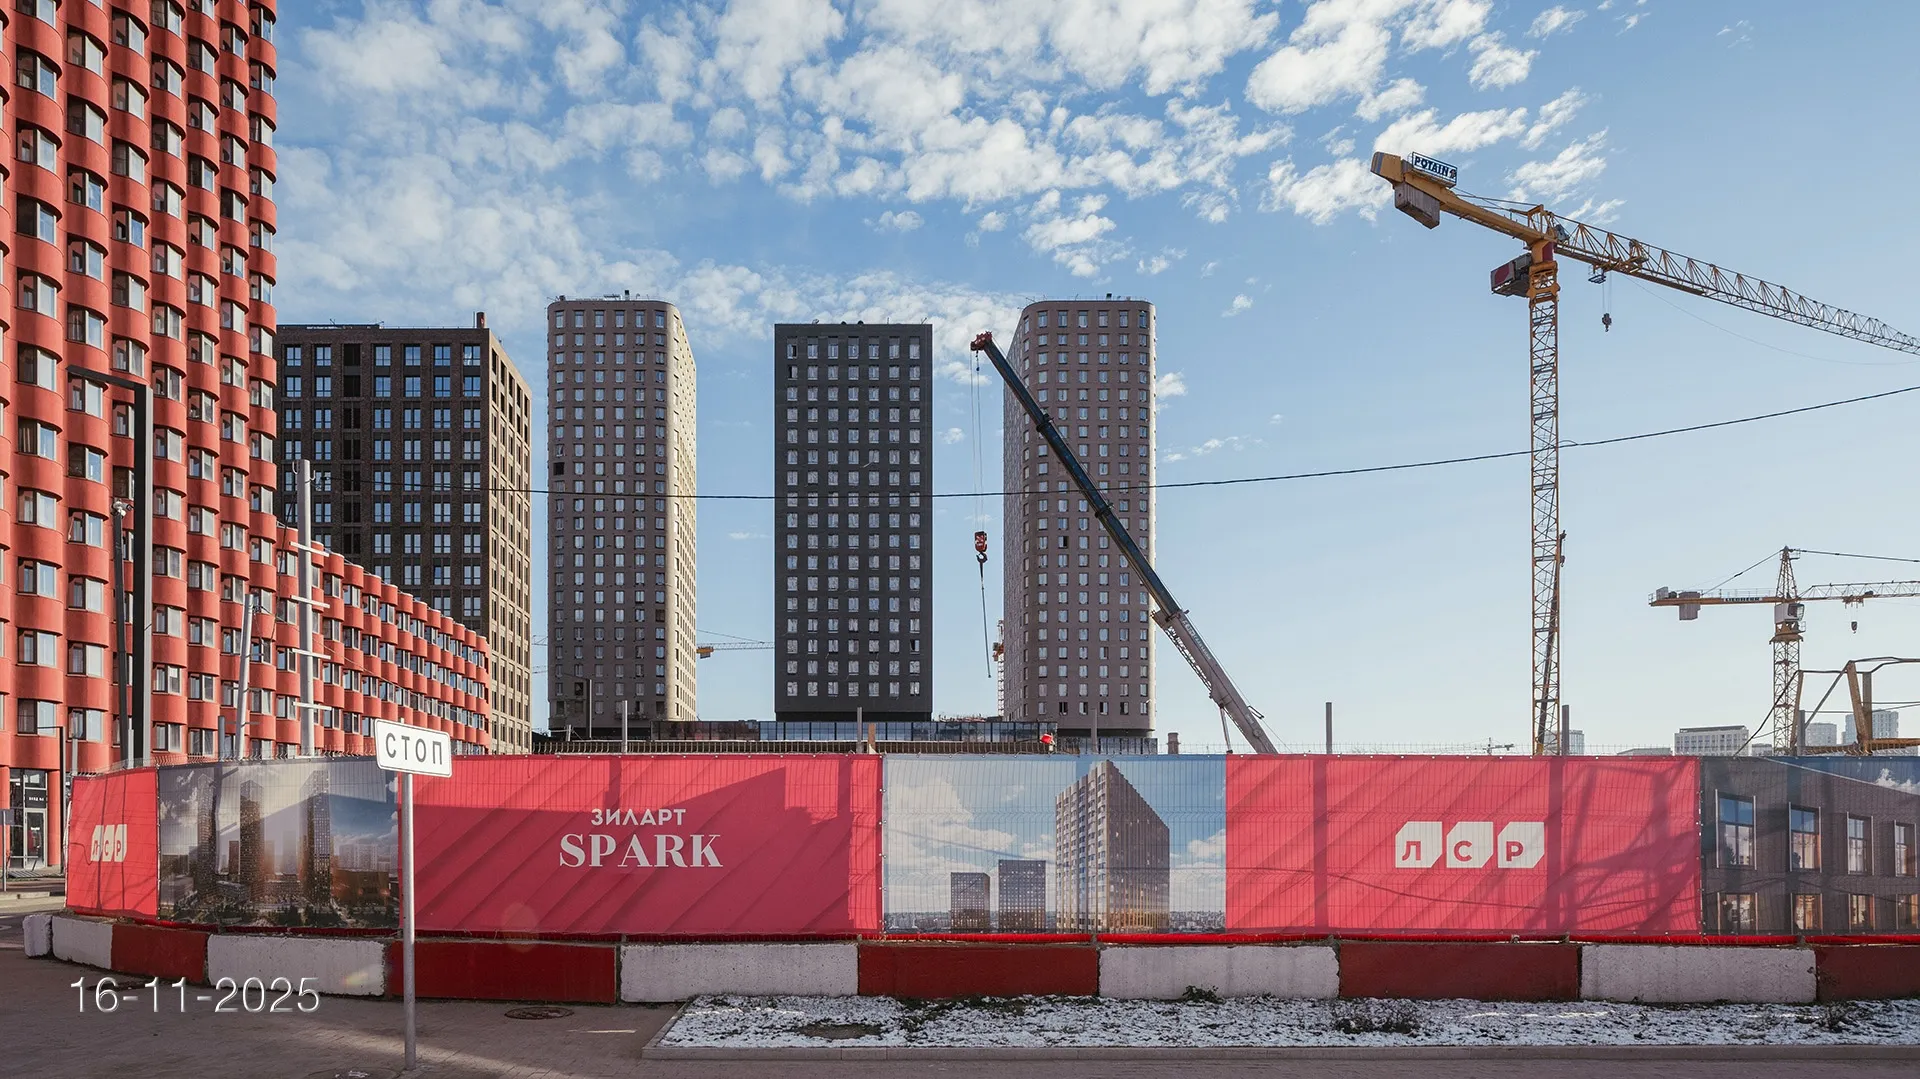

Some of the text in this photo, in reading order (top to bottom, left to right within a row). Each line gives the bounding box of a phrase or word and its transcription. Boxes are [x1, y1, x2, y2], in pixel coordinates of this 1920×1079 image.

[1414, 155, 1449, 178] POTAIN
[385, 732, 443, 765] СТОП
[590, 808, 687, 826] ЗИЛАРТ
[559, 833, 723, 868] SPARK
